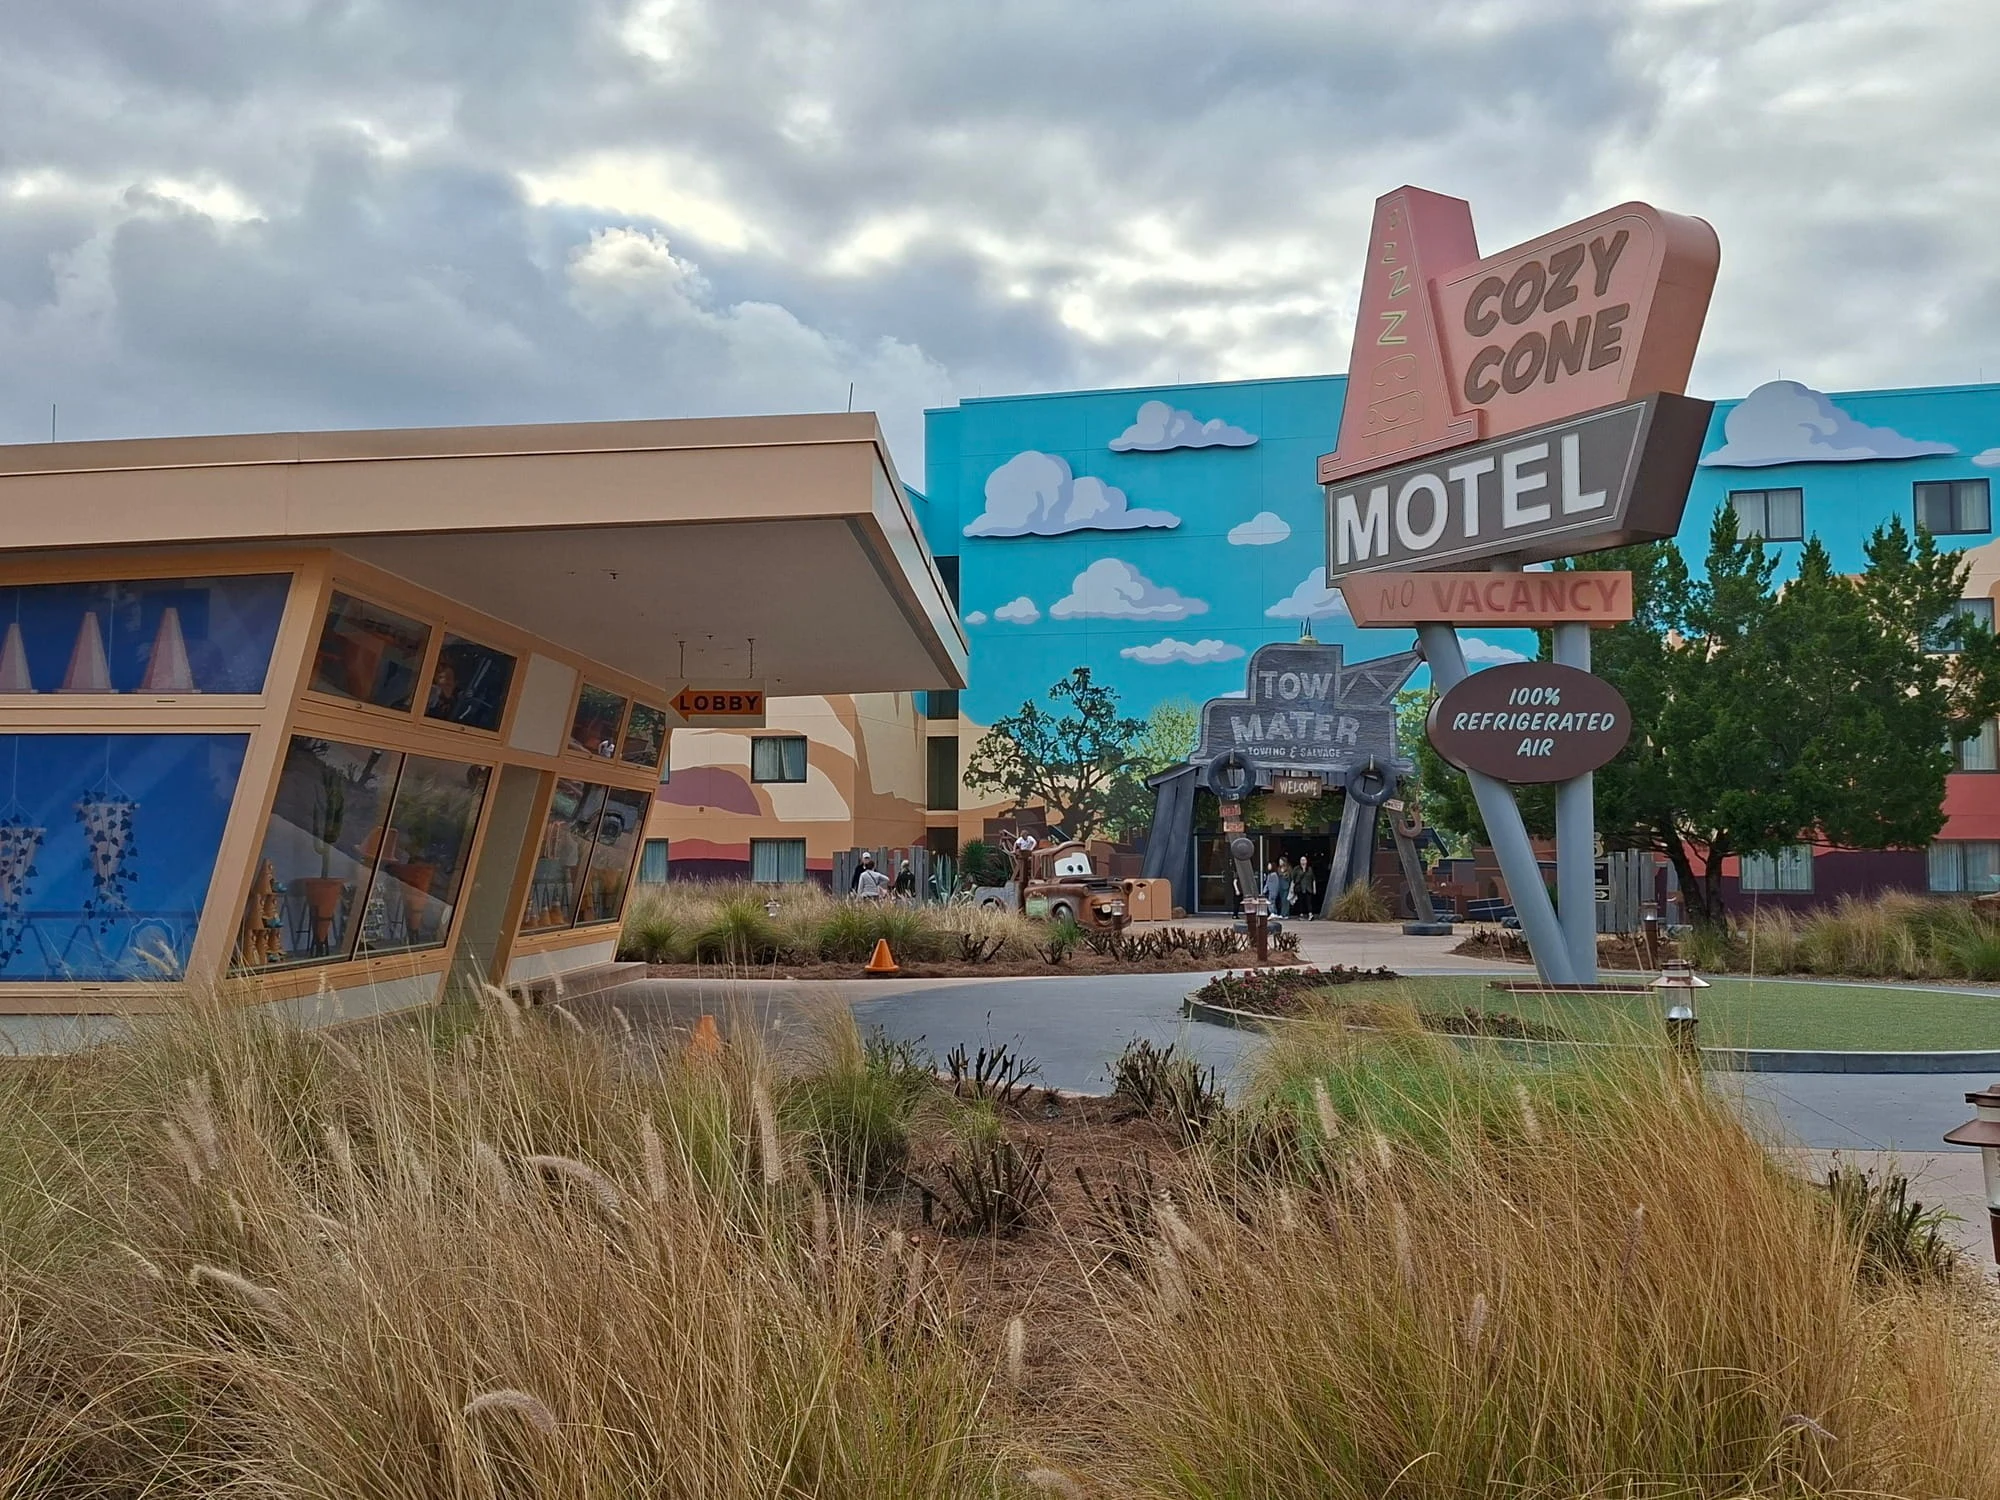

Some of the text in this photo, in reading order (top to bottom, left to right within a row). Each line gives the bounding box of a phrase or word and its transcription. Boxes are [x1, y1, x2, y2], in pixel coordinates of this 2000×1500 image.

[1464, 230, 1630, 337] COZY
[1464, 303, 1630, 404] CONE
[1336, 432, 1607, 565] MOTEL
[1379, 579, 1622, 614] NO VACANCY
[1258, 671, 1333, 700] TOW
[1509, 687, 1561, 707] 100%
[680, 695, 759, 711] LOBBY
[1230, 711, 1361, 746] MATER
[1452, 712, 1616, 733] REFRIGERATED
[1248, 746, 1286, 756] TOWING
[1300, 748, 1341, 758] SALVAGE
[1516, 737, 1555, 757] AIR
